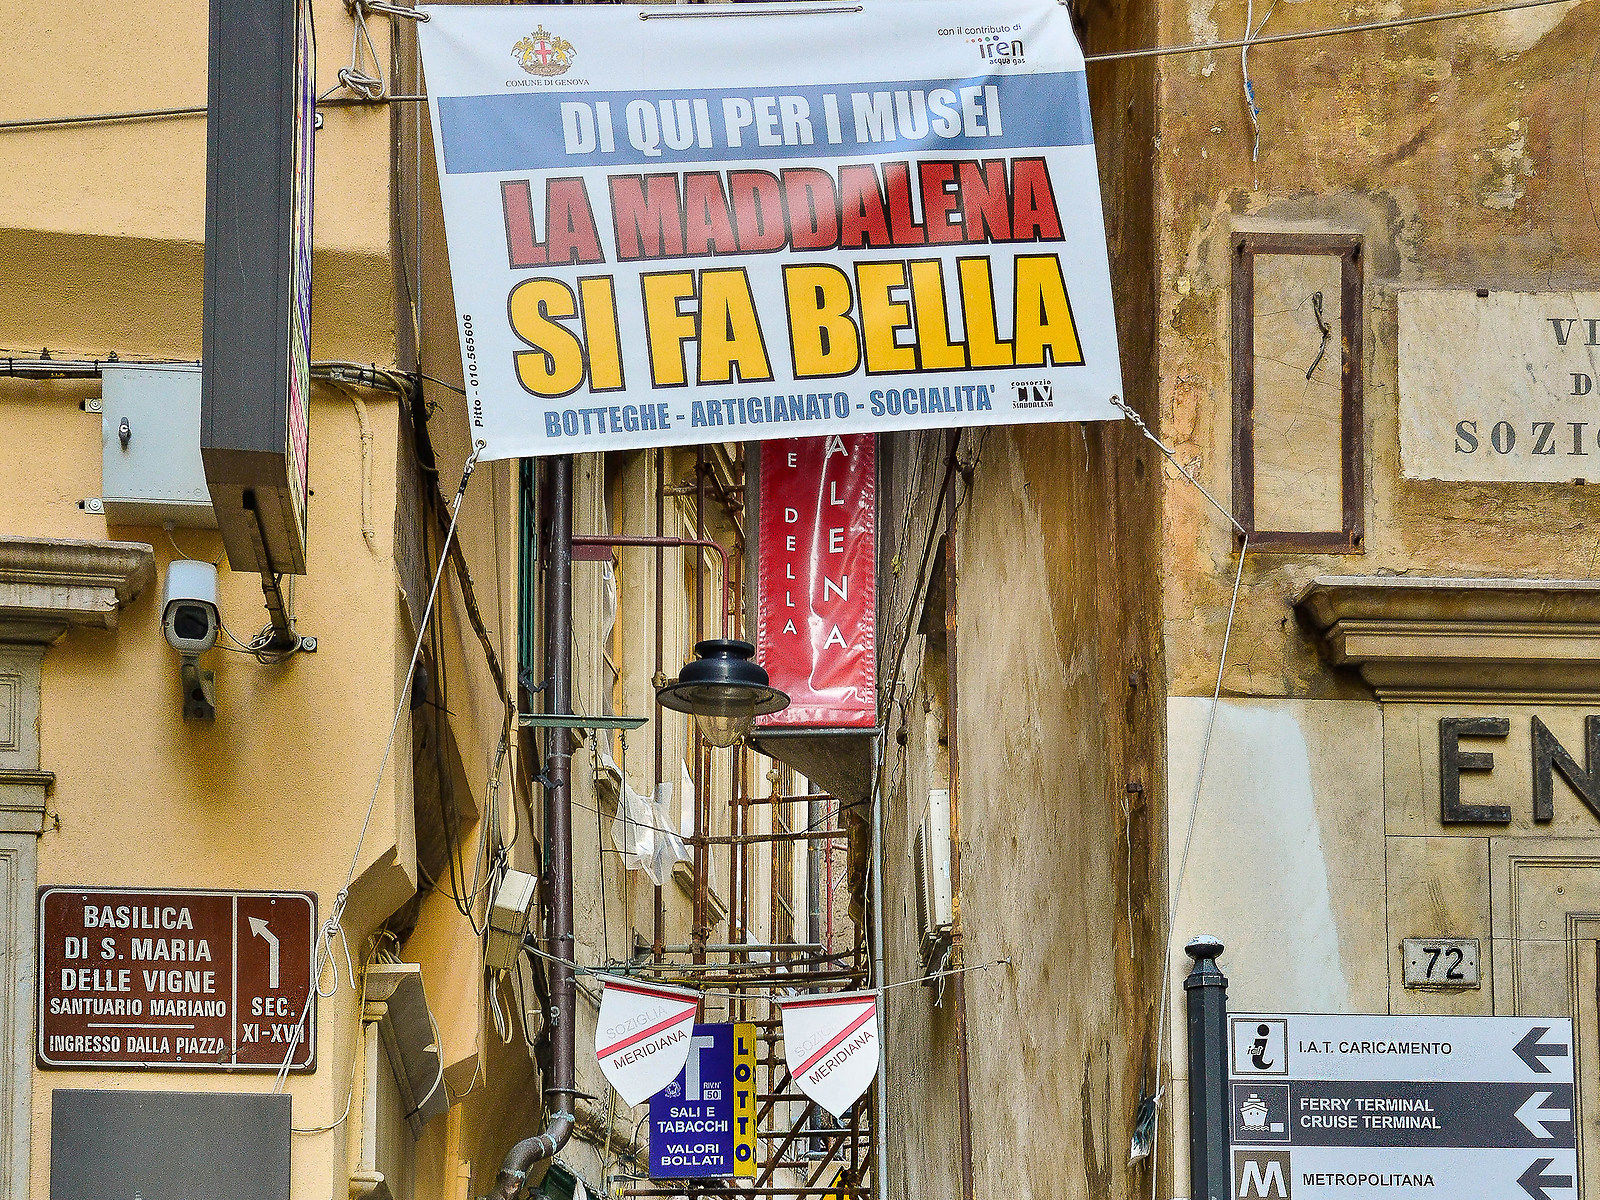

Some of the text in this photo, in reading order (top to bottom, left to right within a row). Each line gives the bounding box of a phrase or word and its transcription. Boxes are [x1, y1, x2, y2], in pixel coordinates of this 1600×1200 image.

[938, 23, 1022, 36] con il contributo di
[979, 39, 1025, 59] iren
[989, 57, 1026, 66] acqua gas
[505, 78, 591, 88] COMUNE DI GENOVA
[560, 86, 1003, 155] DI QUI PER I MUSEI
[500, 155, 1067, 269] LA MADDALENA
[508, 254, 1084, 398] SI FA BELLA
[463, 314, 480, 387] 010.565606
[1011, 379, 1052, 388] consorzio
[1570, 373, 1599, 396] D
[474, 399, 484, 428] Pitto
[544, 404, 670, 439] BOTTEGHE
[691, 393, 850, 427] ARTIGIANATO
[870, 385, 996, 418] SOCIALITA'
[1454, 420, 1600, 456] SOZI
[782, 507, 799, 636] DELLA
[84, 905, 193, 930] BASILICA
[65, 937, 212, 962] DI S. MARIA
[1423, 946, 1464, 981] 72
[61, 968, 216, 994] DELLE VIGNE
[50, 999, 226, 1018] SANTUARIO MARIANO
[251, 997, 296, 1017] SEC.
[606, 1005, 668, 1040] SOZIGLIA
[50, 1035, 226, 1055] INGRESSO DALLA PIAZZA
[613, 1029, 688, 1070] MERIDIANA
[1299, 1041, 1453, 1055] I.A.T. CARICAMENTO
[808, 1031, 875, 1085] MERIDIANA
[707, 1090, 719, 1100] 50
[734, 1036, 752, 1163] LOTTO
[1299, 1098, 1435, 1112] FERRY TERMINAL
[670, 1106, 716, 1118] SALI E
[1299, 1115, 1442, 1130] CRUISE TERMINAL
[657, 1121, 729, 1134] TABACCHI
[666, 1143, 720, 1155] VALORI
[661, 1156, 724, 1167] BOLLATI
[1302, 1173, 1436, 1188] METROPOLITANA
